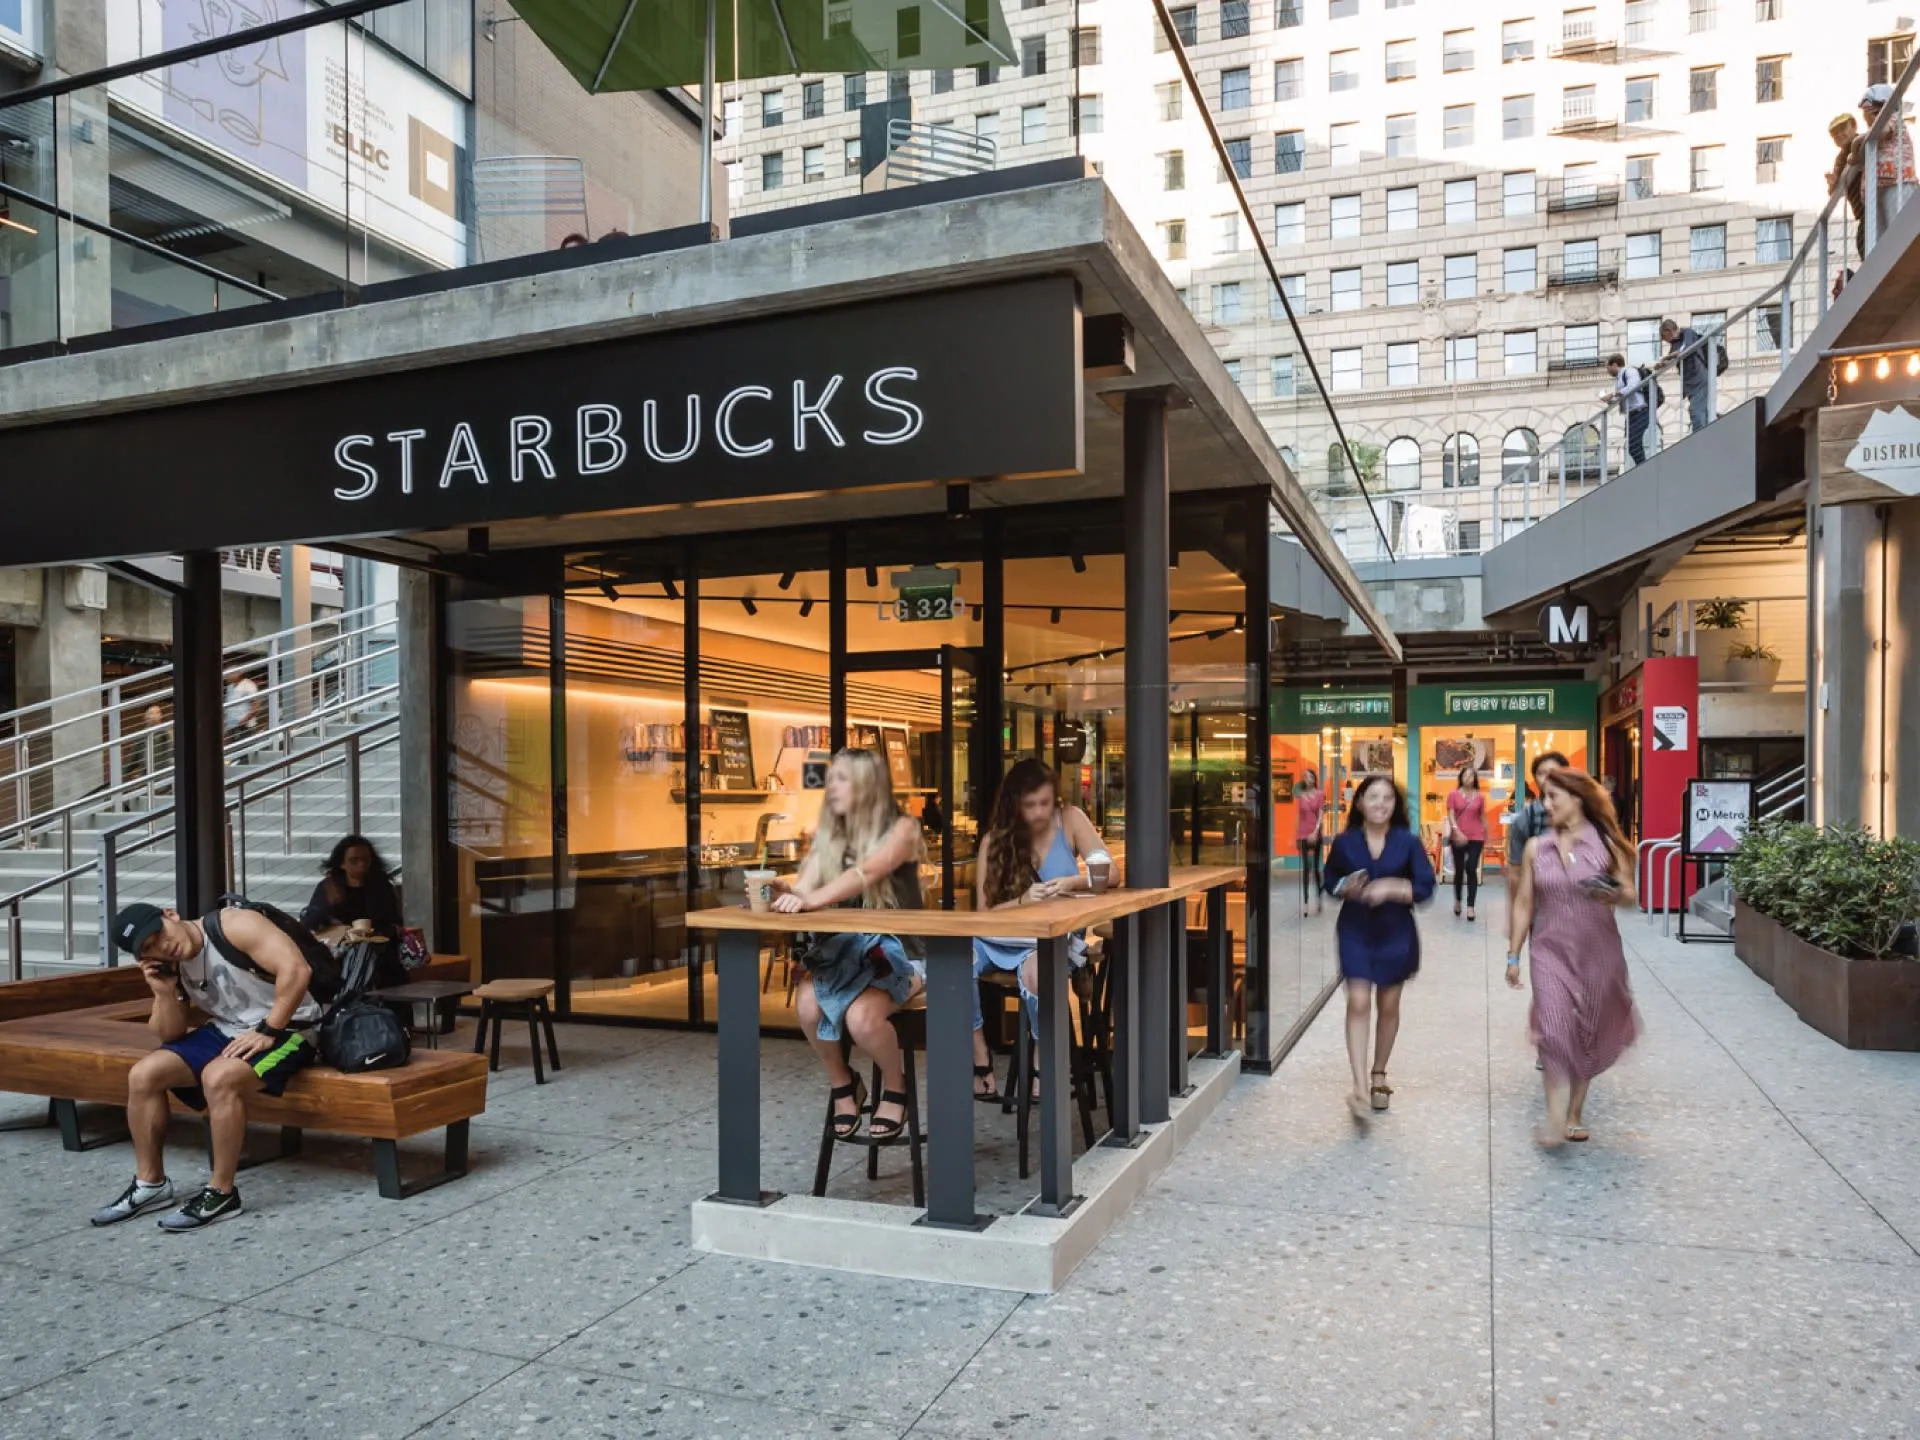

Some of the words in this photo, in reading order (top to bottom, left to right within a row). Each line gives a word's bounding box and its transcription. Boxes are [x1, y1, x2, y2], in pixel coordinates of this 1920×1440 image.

[334, 367, 923, 499] STARBUCKS
[878, 599, 909, 621] LG
[917, 596, 966, 618] 320
[1549, 606, 1588, 643] M
[1452, 696, 1547, 712] EVERYTABLE
[1713, 810, 1745, 820] Metro
